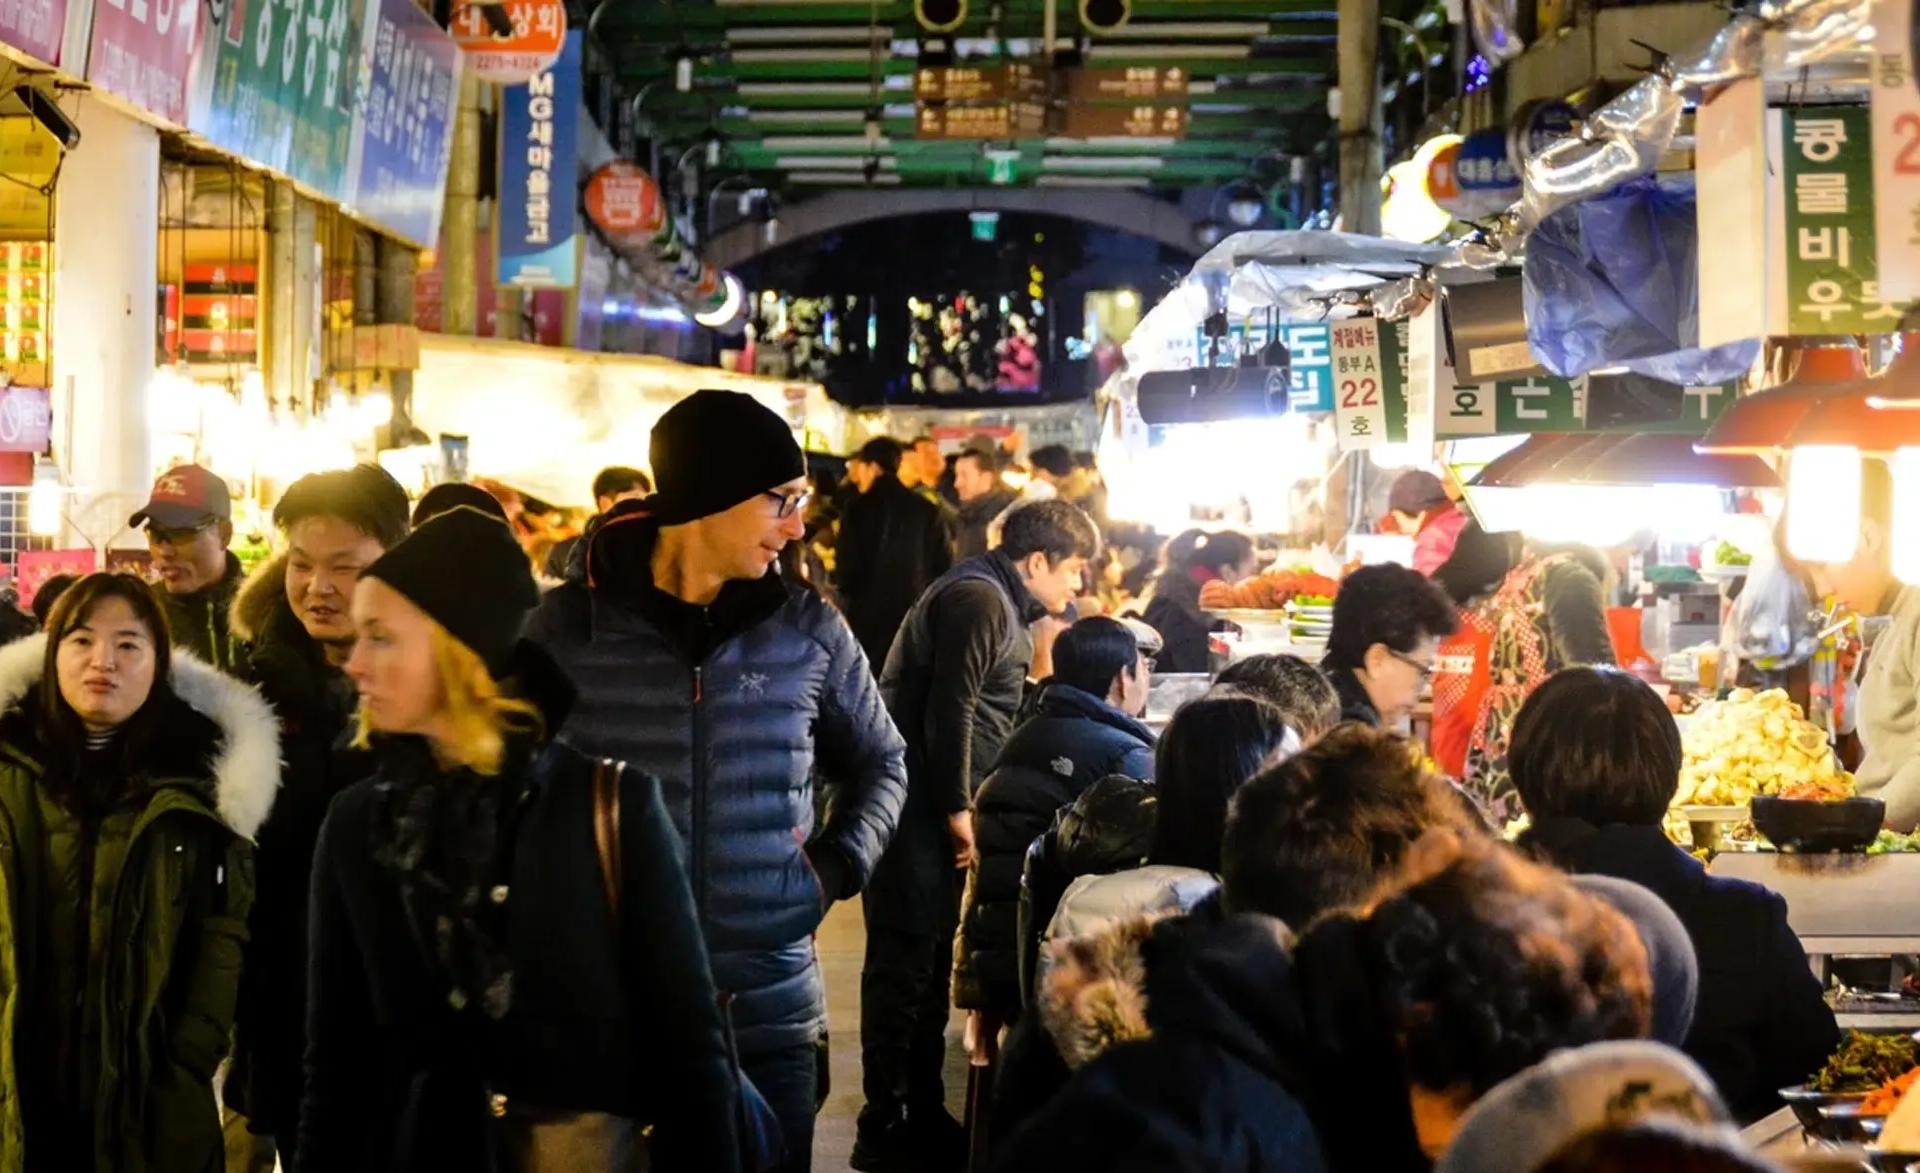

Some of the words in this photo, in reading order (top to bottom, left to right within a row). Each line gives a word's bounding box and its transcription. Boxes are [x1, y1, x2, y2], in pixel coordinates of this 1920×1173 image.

[525, 71, 554, 243] MG새마을금고
[1333, 325, 1375, 348] 계절메뉴
[1338, 355, 1361, 373] 동부
[1364, 355, 1376, 373] A
[1340, 377, 1378, 409] 22
[1350, 415, 1373, 436] 호
